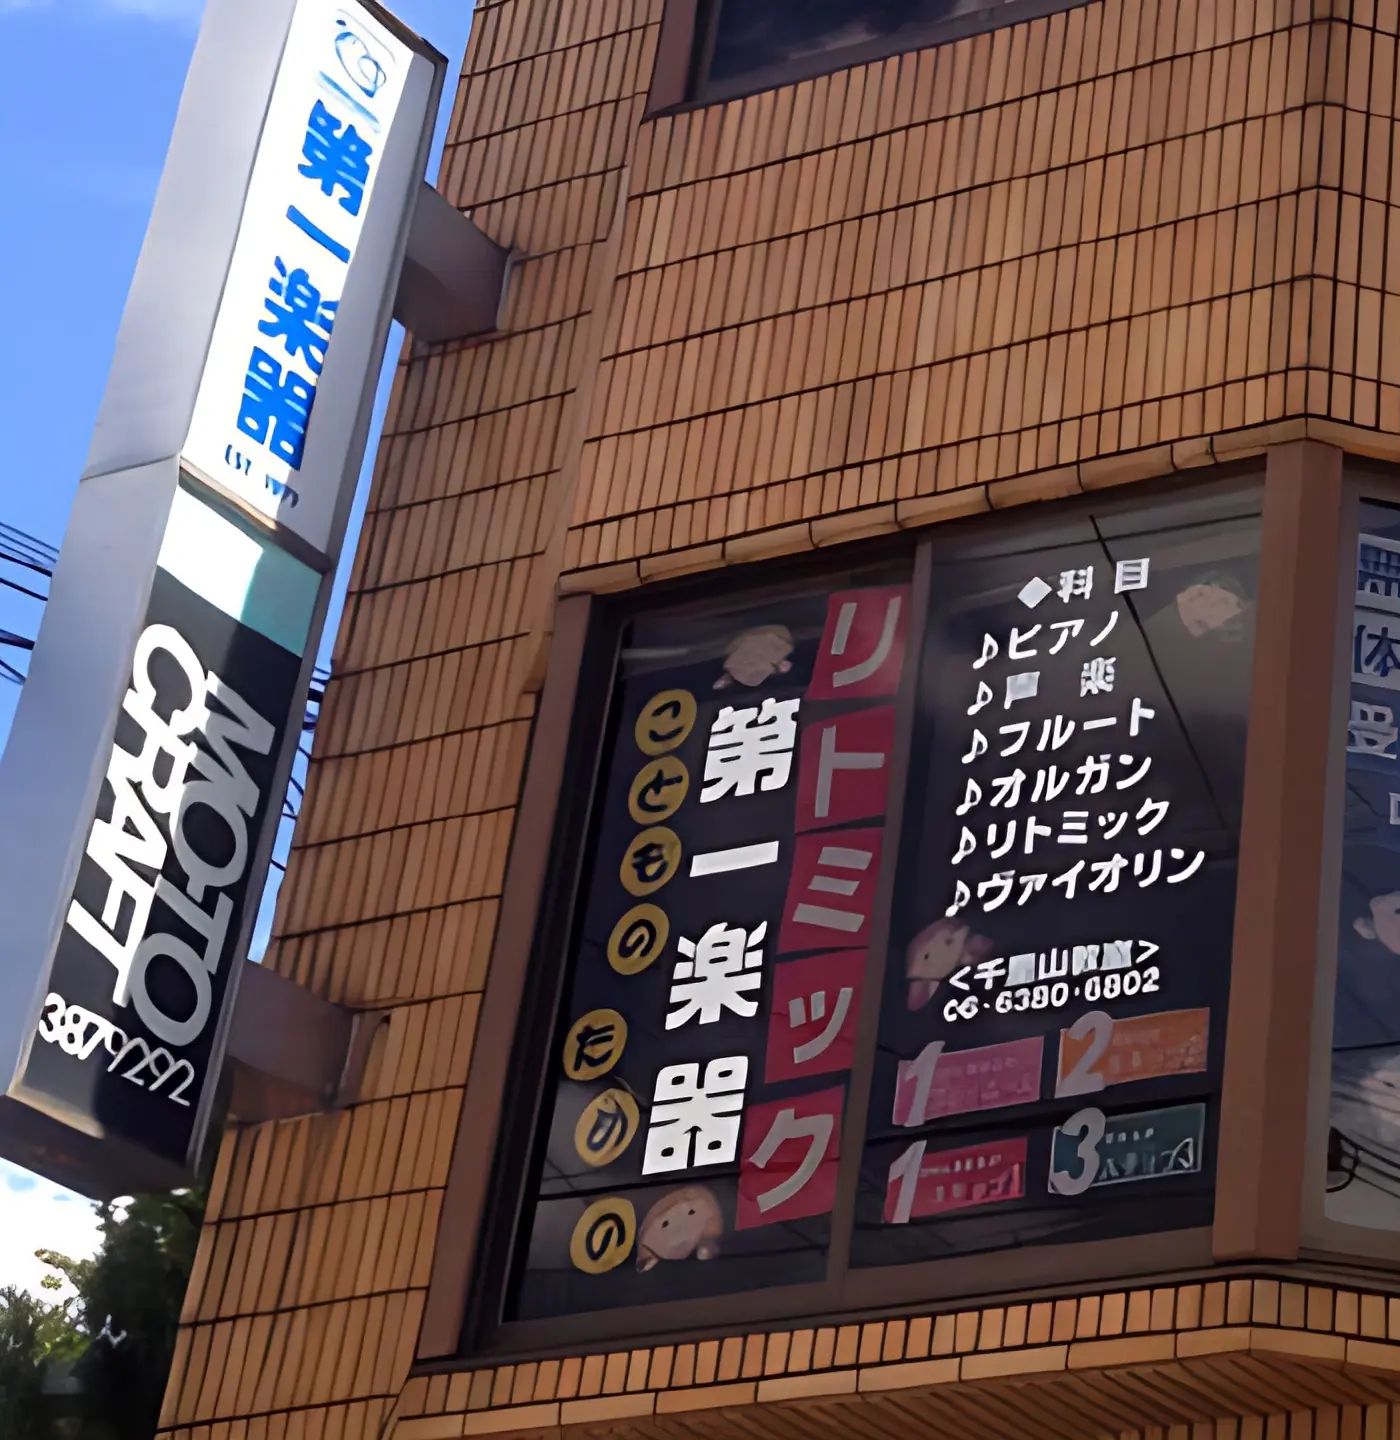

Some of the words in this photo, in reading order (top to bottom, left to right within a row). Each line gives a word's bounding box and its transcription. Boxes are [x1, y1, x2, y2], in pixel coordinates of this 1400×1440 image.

[236, 98, 373, 471] 第一楽器
[67, 623, 210, 1008] CRAFT
[985, 796, 1171, 860] リトミック
[988, 753, 1152, 809] オルガン
[998, 696, 1156, 758] フルート
[641, 697, 801, 1176] 第一楽器
[749, 595, 902, 1214] リトミック
[975, 847, 1206, 914] ヴァイオリン
